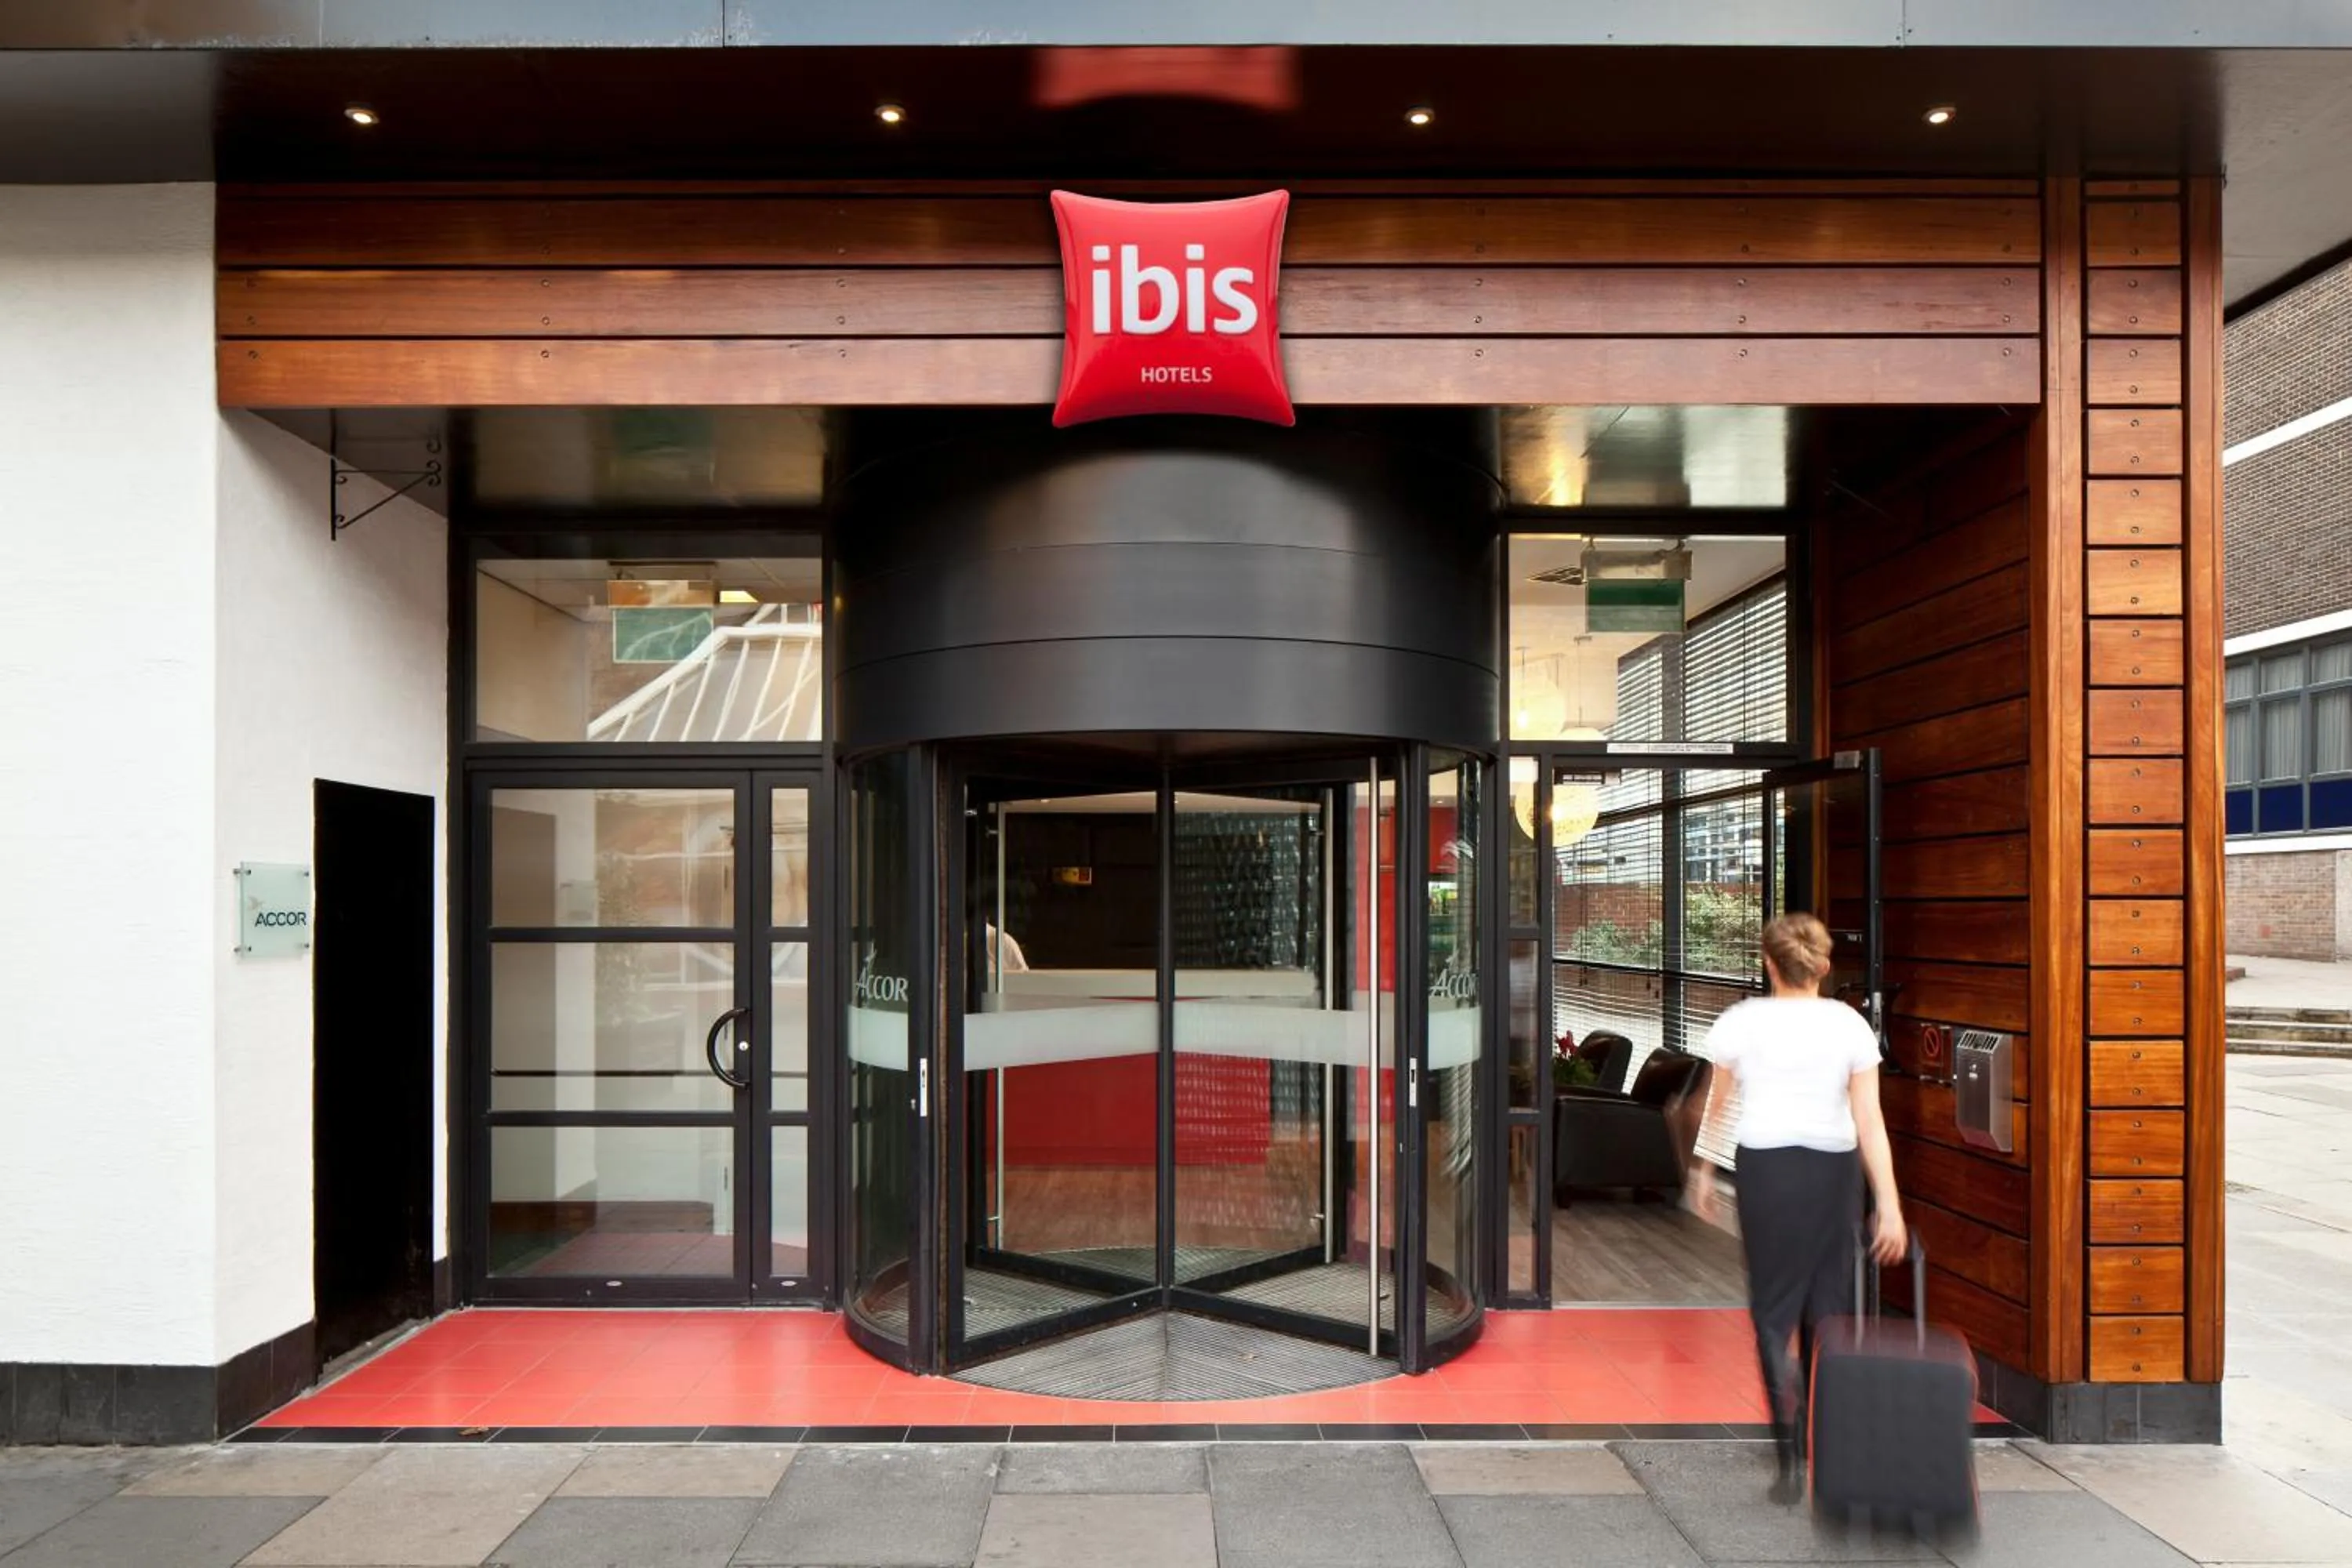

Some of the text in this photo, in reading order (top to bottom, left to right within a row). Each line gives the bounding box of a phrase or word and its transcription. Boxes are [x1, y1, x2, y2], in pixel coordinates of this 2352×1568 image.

[1092, 244, 1258, 334] ibis
[1141, 367, 1212, 383] HOTELS
[255, 912, 307, 927] ACCOR
[855, 967, 908, 1002] ACCOR
